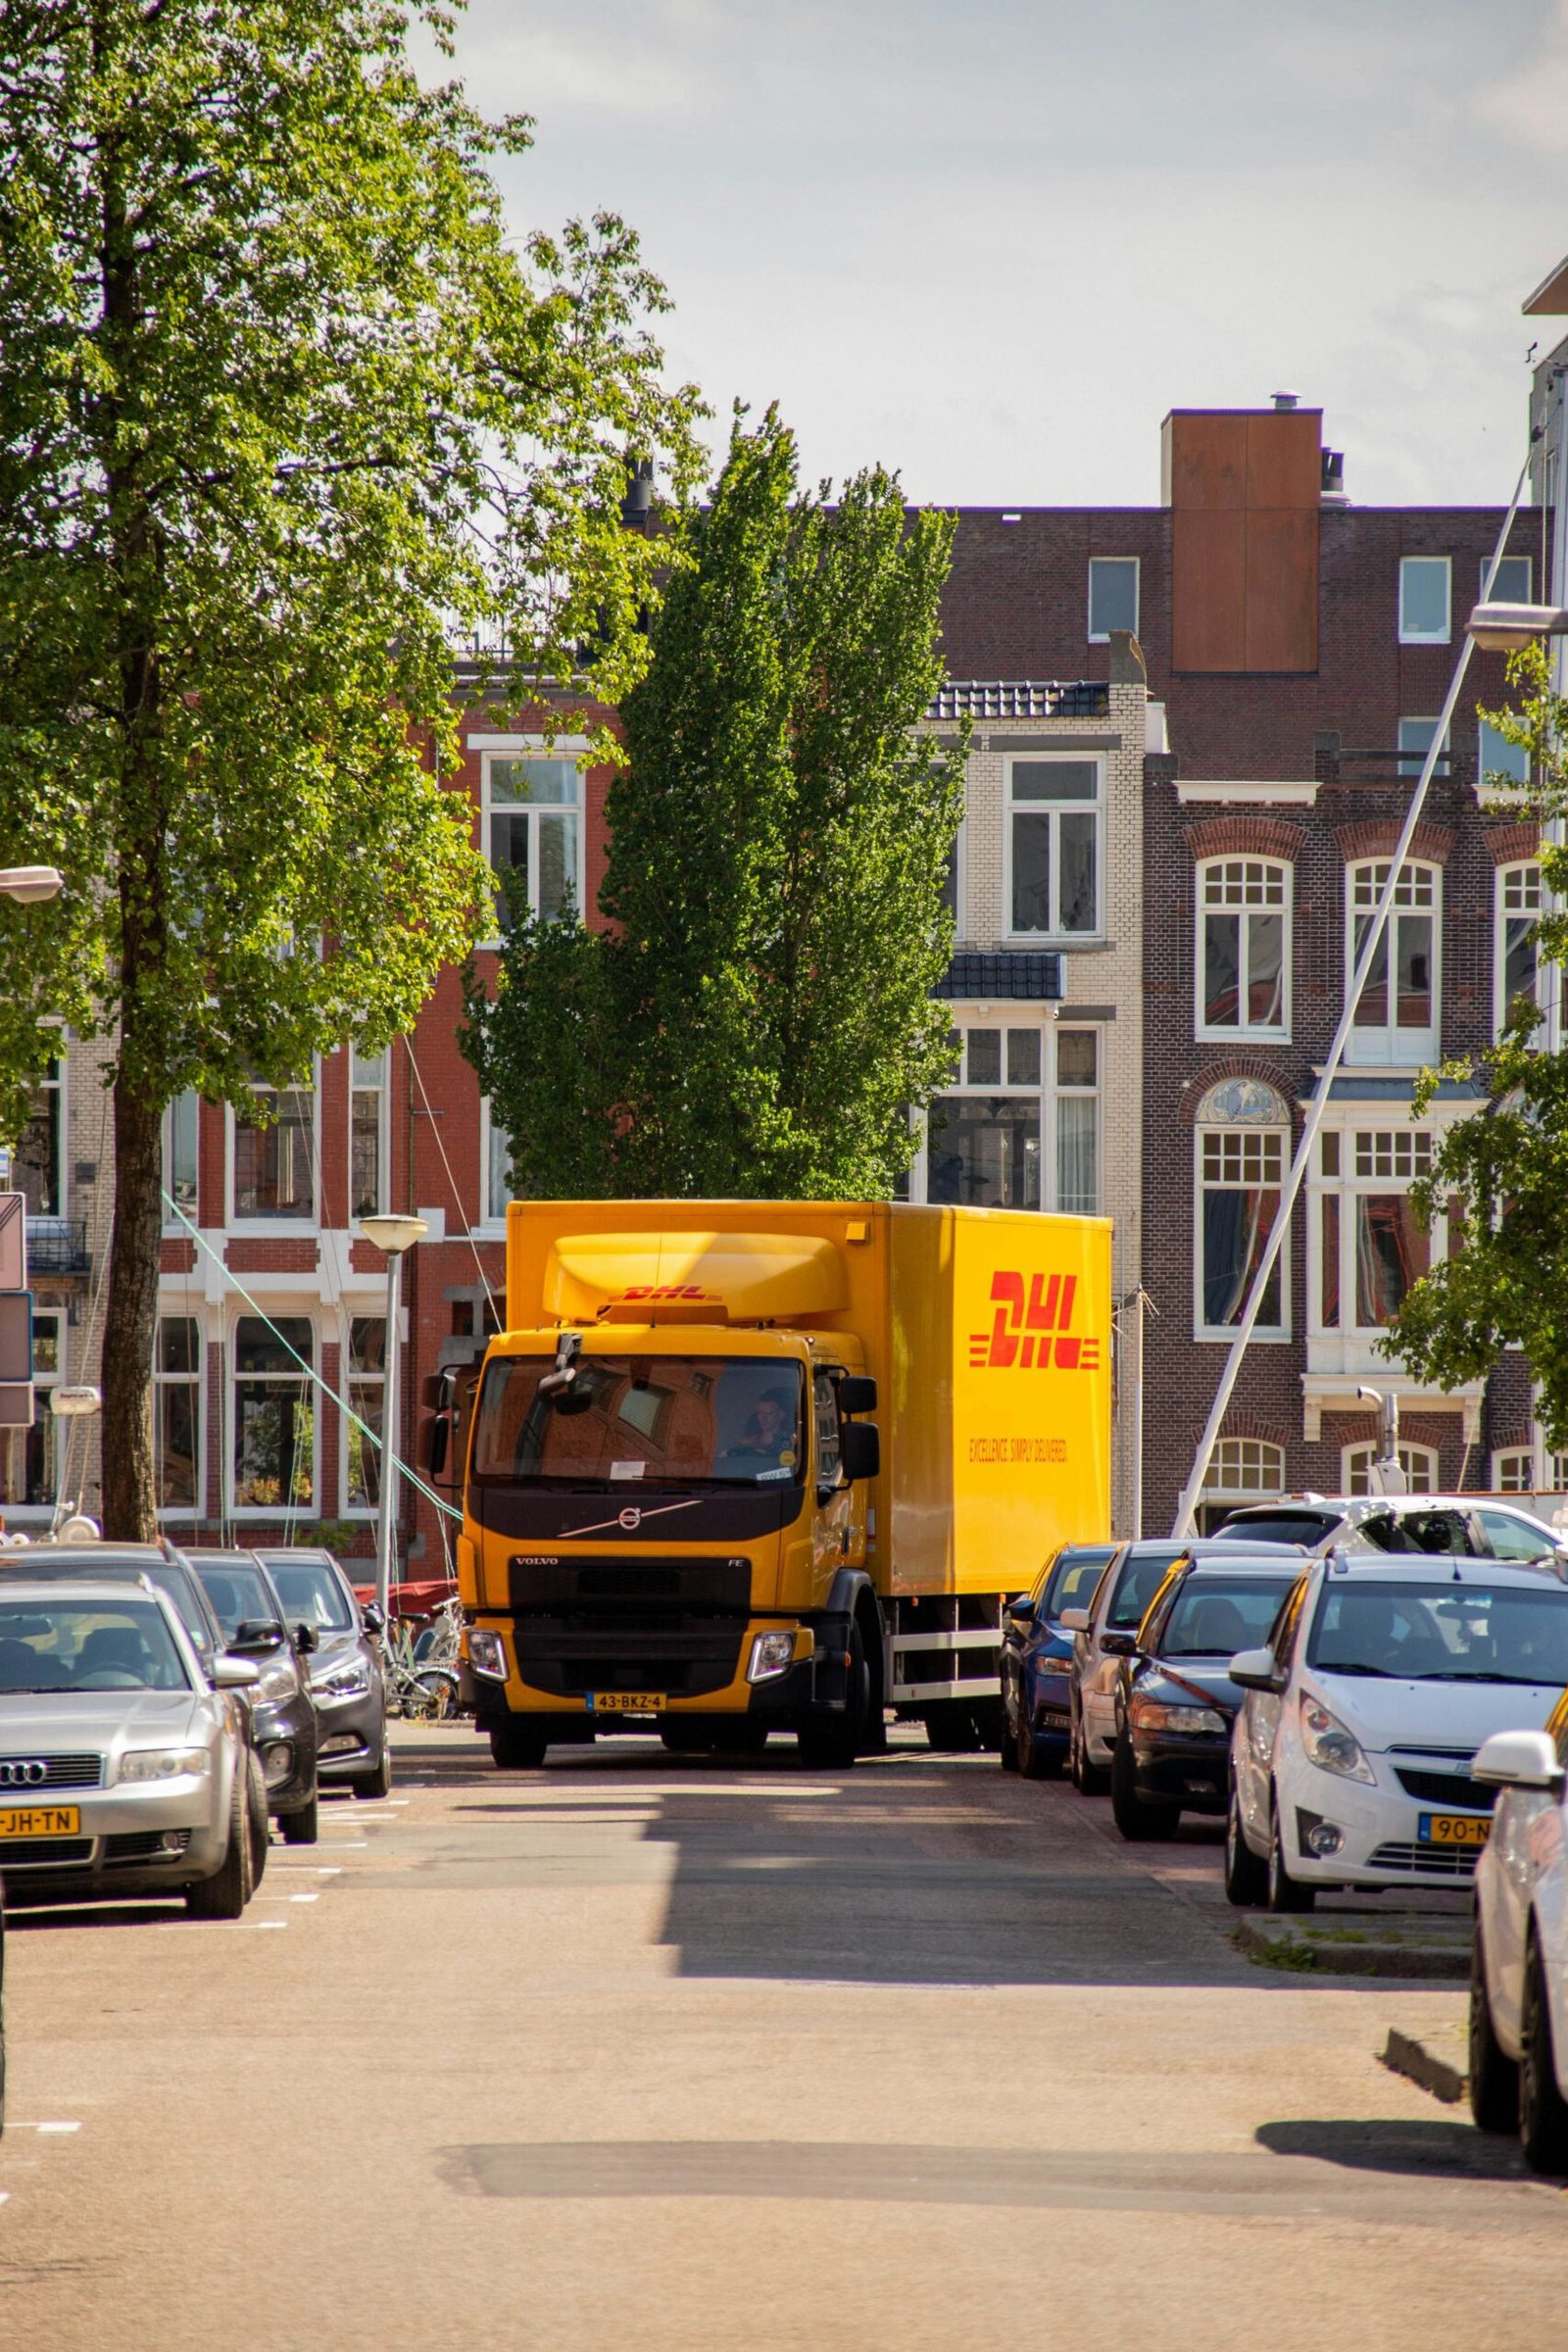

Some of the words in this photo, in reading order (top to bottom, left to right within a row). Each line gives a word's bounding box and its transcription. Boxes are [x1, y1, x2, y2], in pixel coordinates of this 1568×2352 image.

[622, 1286, 707, 1300] DHL
[988, 1271, 1082, 1369] DHL
[1010, 1438, 1034, 1462] SIMPLY
[515, 1557, 559, 1566] VOLVO
[599, 1695, 661, 1708] 43-BKZ-4
